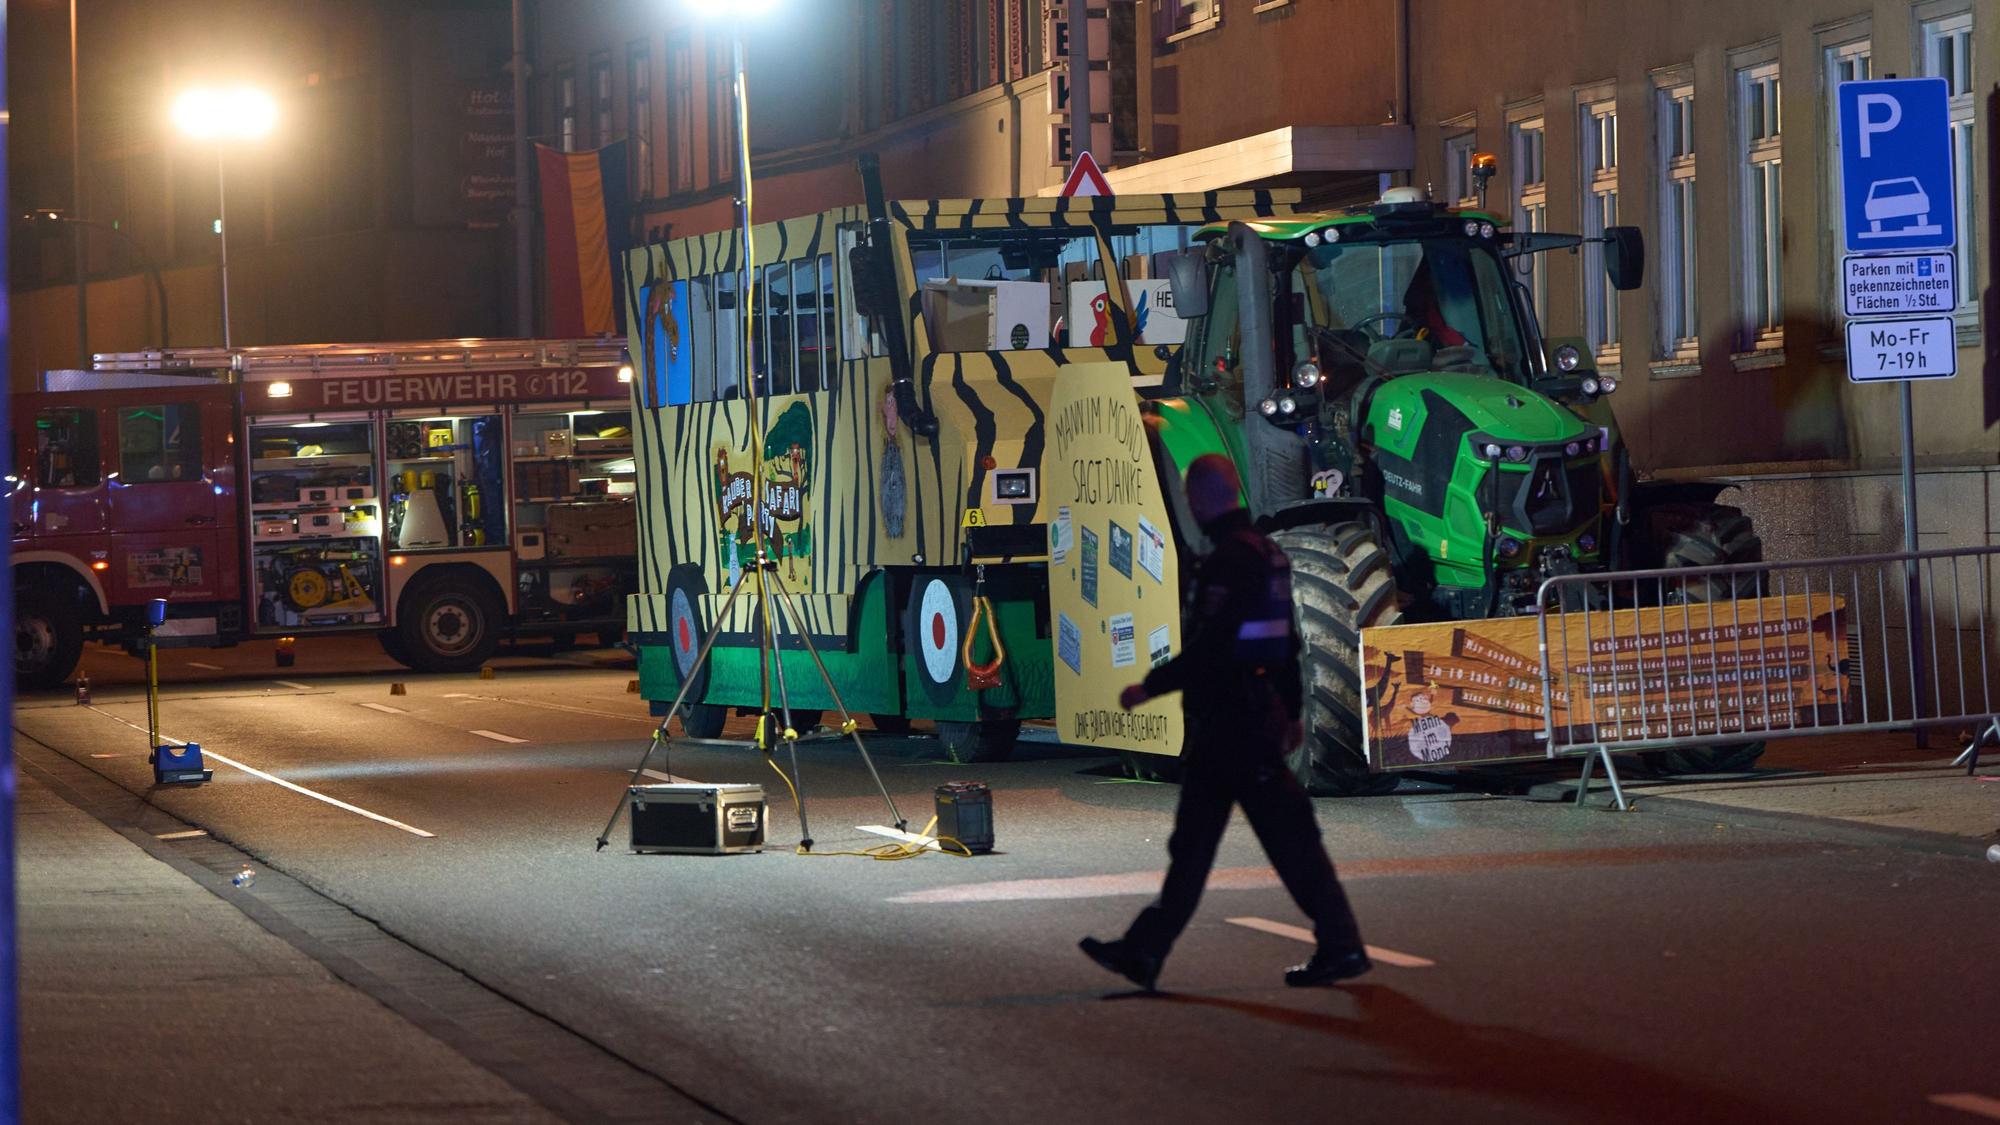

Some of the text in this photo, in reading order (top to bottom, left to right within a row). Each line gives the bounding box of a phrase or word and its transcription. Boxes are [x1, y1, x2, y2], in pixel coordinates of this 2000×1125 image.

[1857, 93, 1902, 158] P
[1852, 260, 1945, 276] Parken mit in
[1849, 278, 1949, 296] gekennzeichneten
[1157, 291, 1175, 308] HE
[1856, 296, 1900, 309] Flächen
[1918, 294, 1941, 307] Std.
[1870, 328, 1930, 347] Mo-Fr
[322, 371, 588, 404] FEUERWEHR 112
[1055, 396, 1143, 463] MANN IM MOND
[1072, 457, 1144, 506] SAGT DANKE
[1383, 469, 1423, 496] DEUTZ-FAHR
[722, 477, 800, 515] KAUBER SAFARI
[746, 503, 775, 539] PRTY
[969, 510, 977, 525] 6
[1757, 652, 1775, 662] ach
[1766, 665, 1802, 678] Tigr!
[1607, 706, 1627, 718] Wr
[1412, 715, 1442, 734] Mann
[1423, 731, 1438, 747] im
[1420, 741, 1451, 762] Mond
